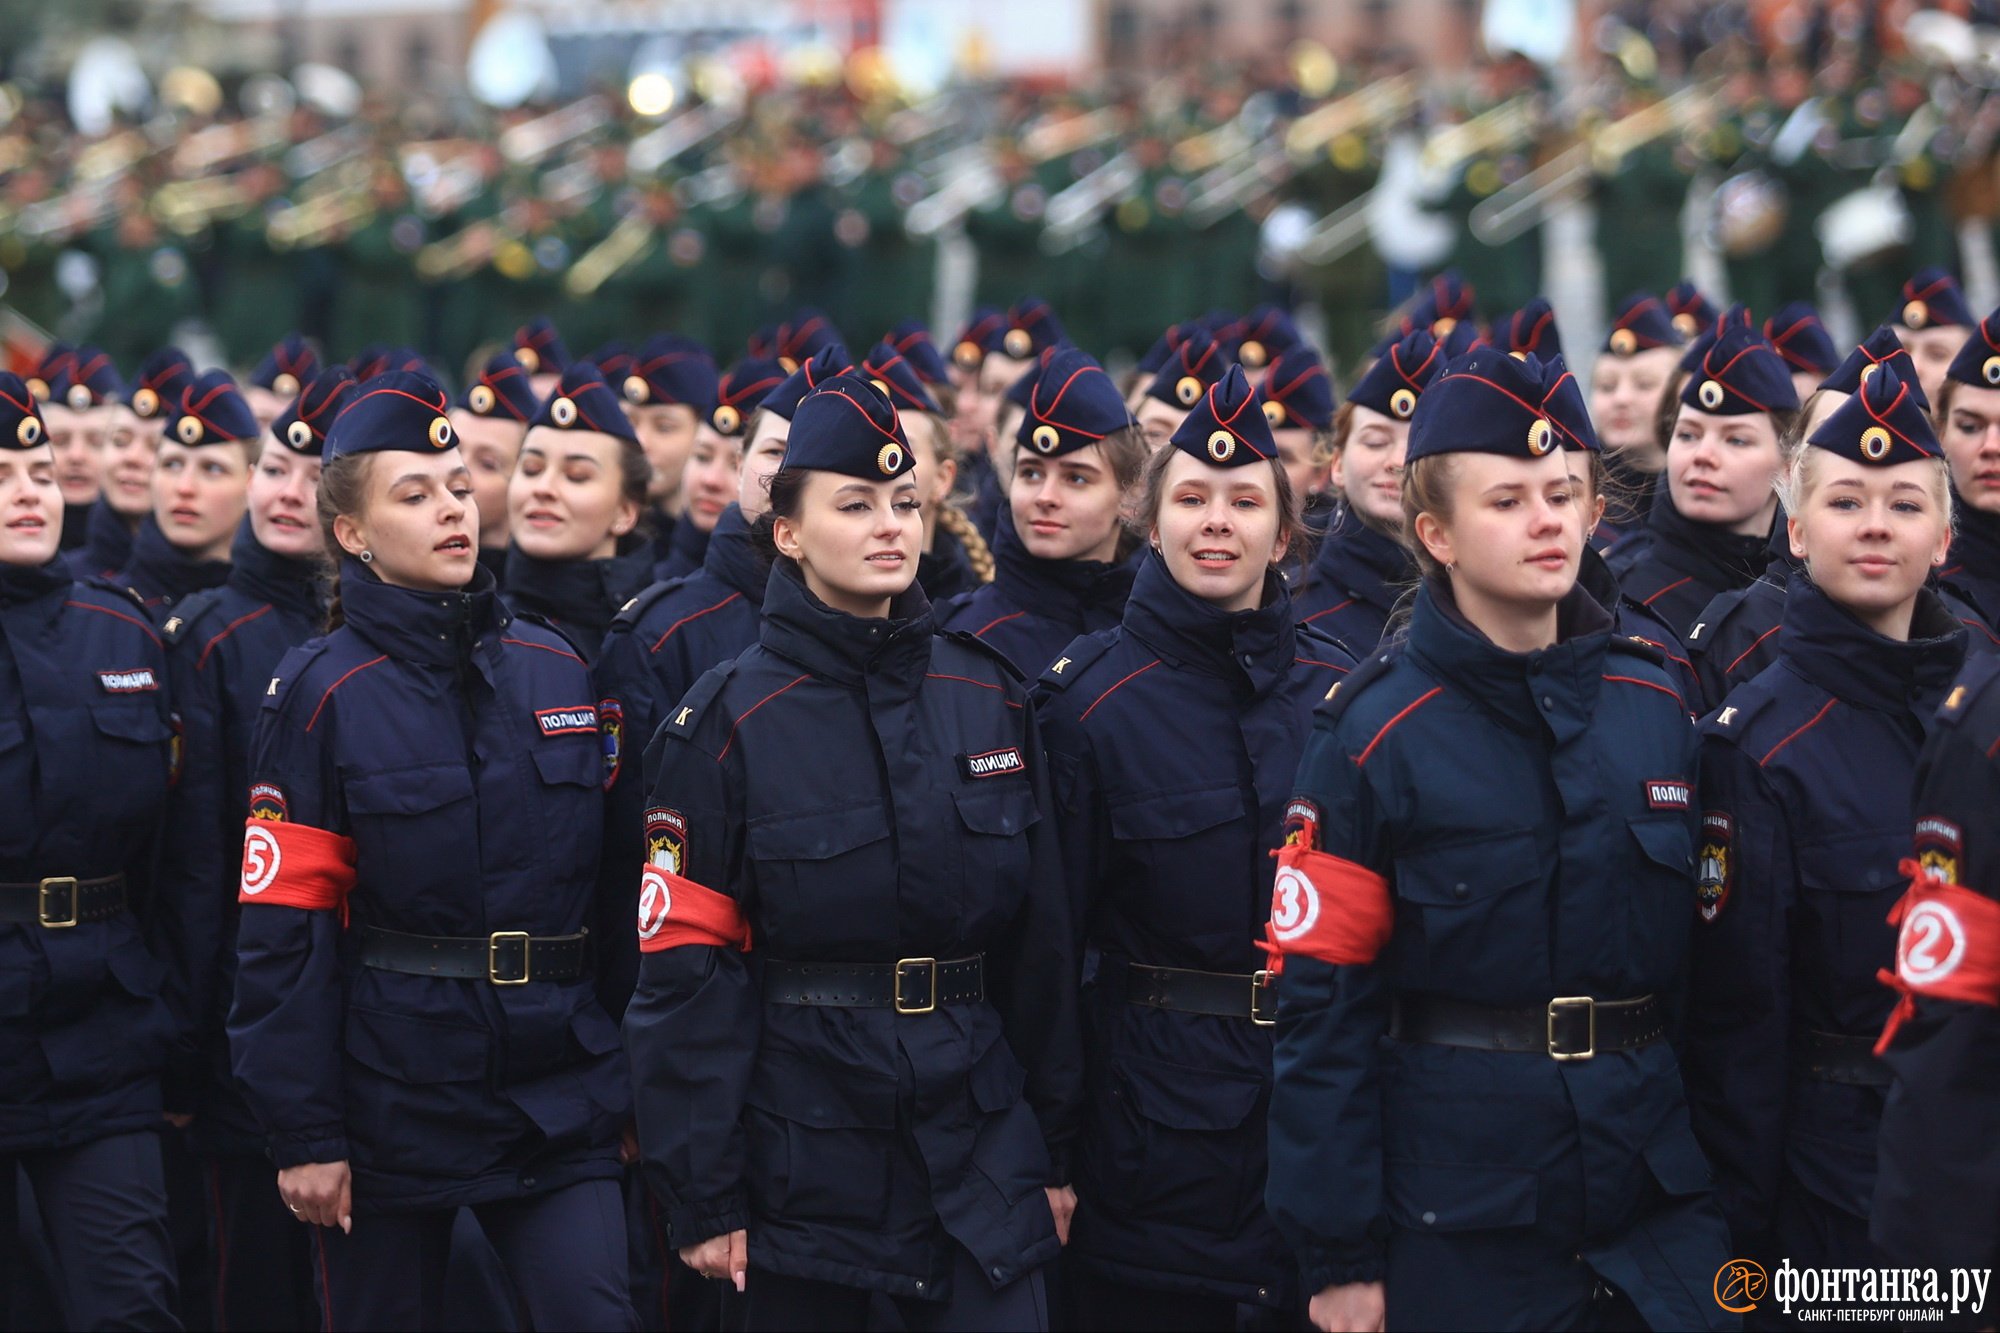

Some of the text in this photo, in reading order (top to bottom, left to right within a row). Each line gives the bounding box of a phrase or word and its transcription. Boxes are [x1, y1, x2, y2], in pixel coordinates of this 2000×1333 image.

[1051, 656, 1071, 675] К
[267, 678, 280, 695] К
[540, 711, 597, 730] ПОЛИЦИЯ
[675, 706, 694, 726] К
[1716, 707, 1738, 726] К
[969, 751, 1020, 773] ОЛИЦИЯ
[1651, 785, 1688, 805] ПОЛИЦ
[647, 811, 683, 829] ПОЛИЦИЯ
[1915, 820, 1958, 842] ПОЛИЦИЯ
[244, 839, 269, 882] 5
[638, 881, 659, 929] 4
[1273, 874, 1301, 928] 3
[1907, 913, 1943, 970] 2
